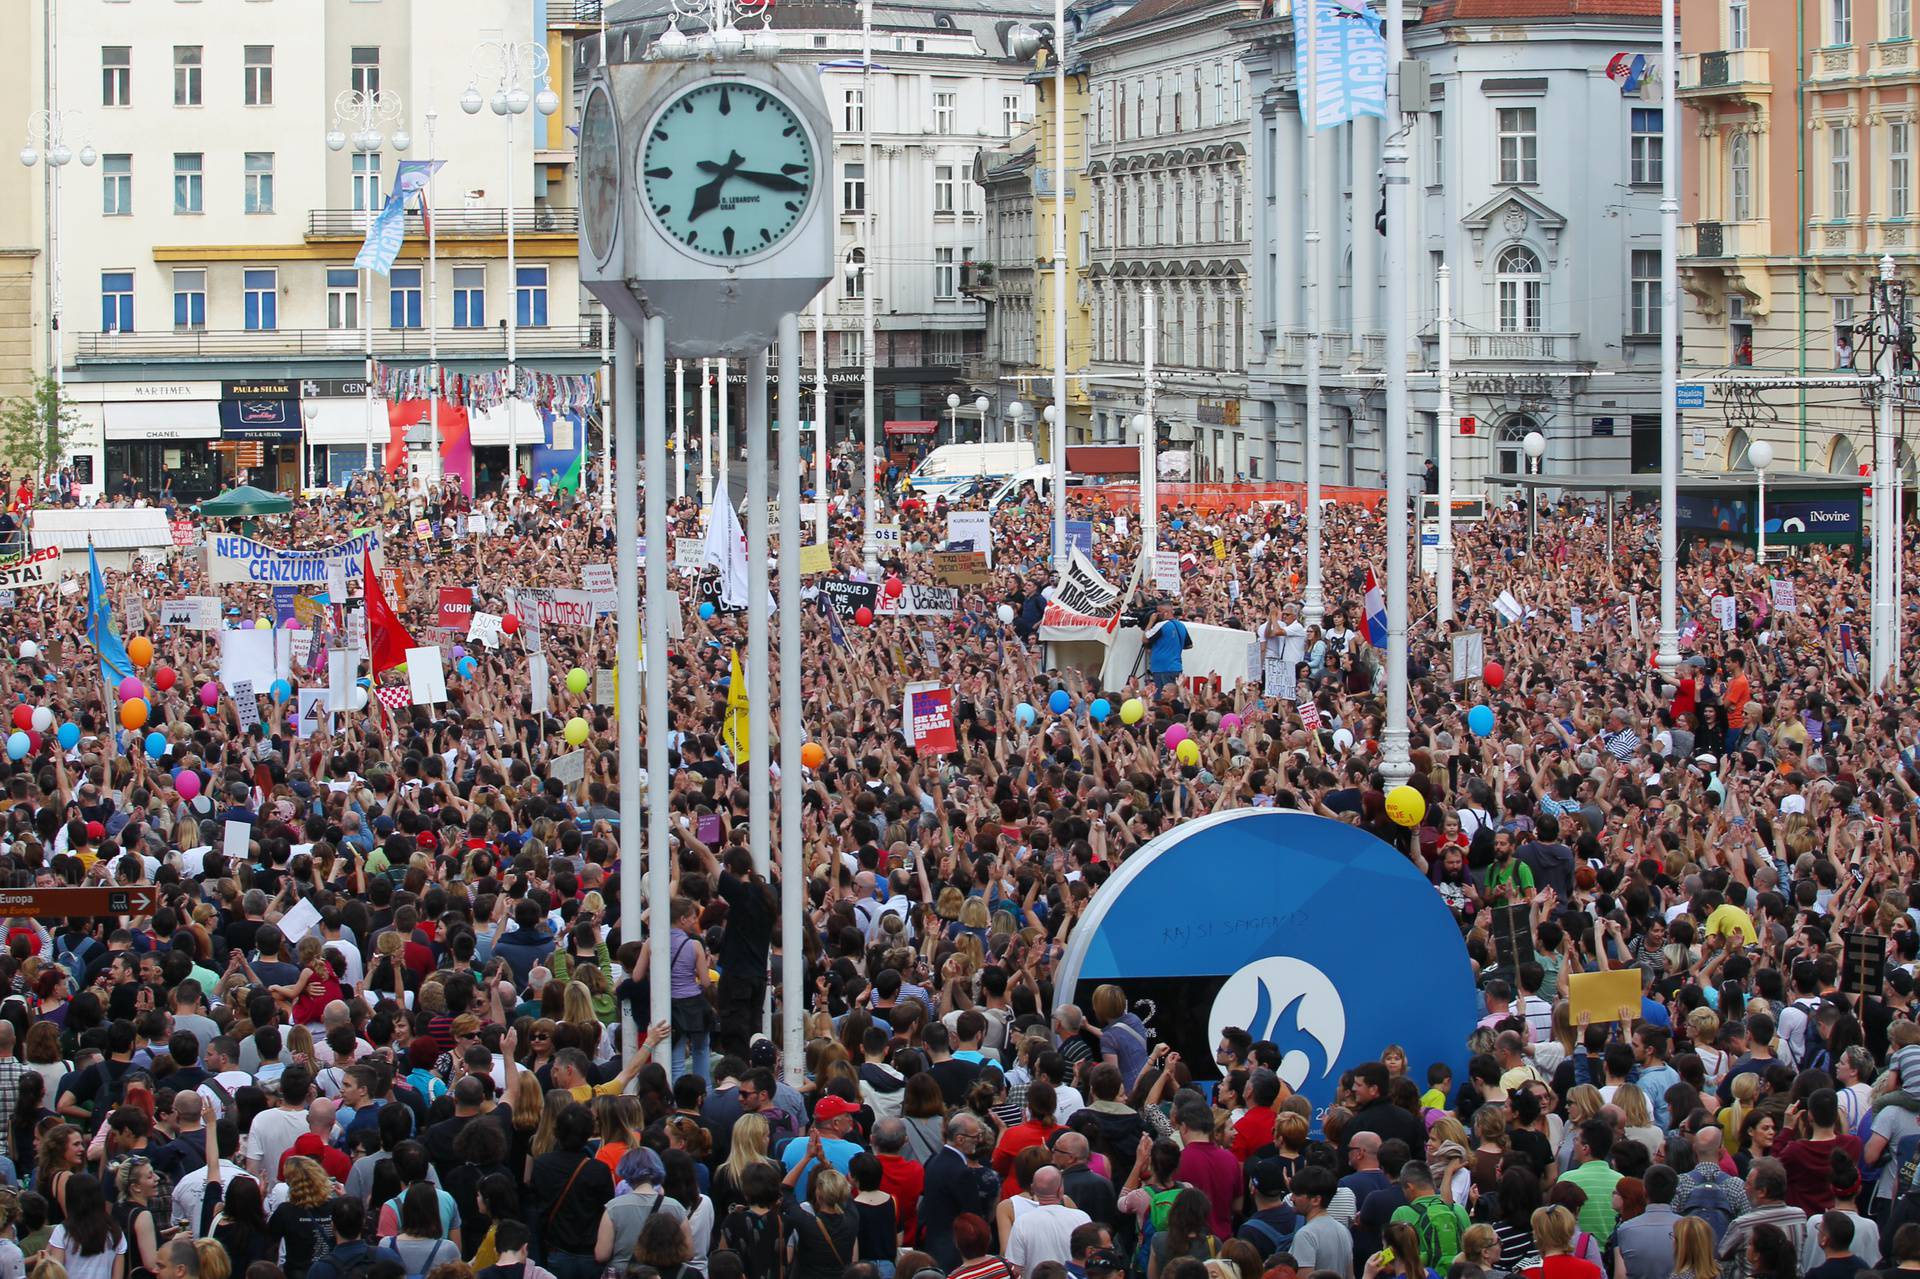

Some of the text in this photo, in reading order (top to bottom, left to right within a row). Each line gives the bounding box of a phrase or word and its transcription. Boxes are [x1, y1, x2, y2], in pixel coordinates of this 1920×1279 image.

[832, 374, 865, 382] BANKA
[135, 386, 192, 395] MARTIMEX
[342, 383, 367, 394] CEN
[1465, 378, 1553, 394] MARQUISE
[1810, 510, 1850, 523] iNovine
[824, 581, 869, 596] PROSVJED
[835, 594, 849, 603] NE
[0, 893, 33, 905] Europa
